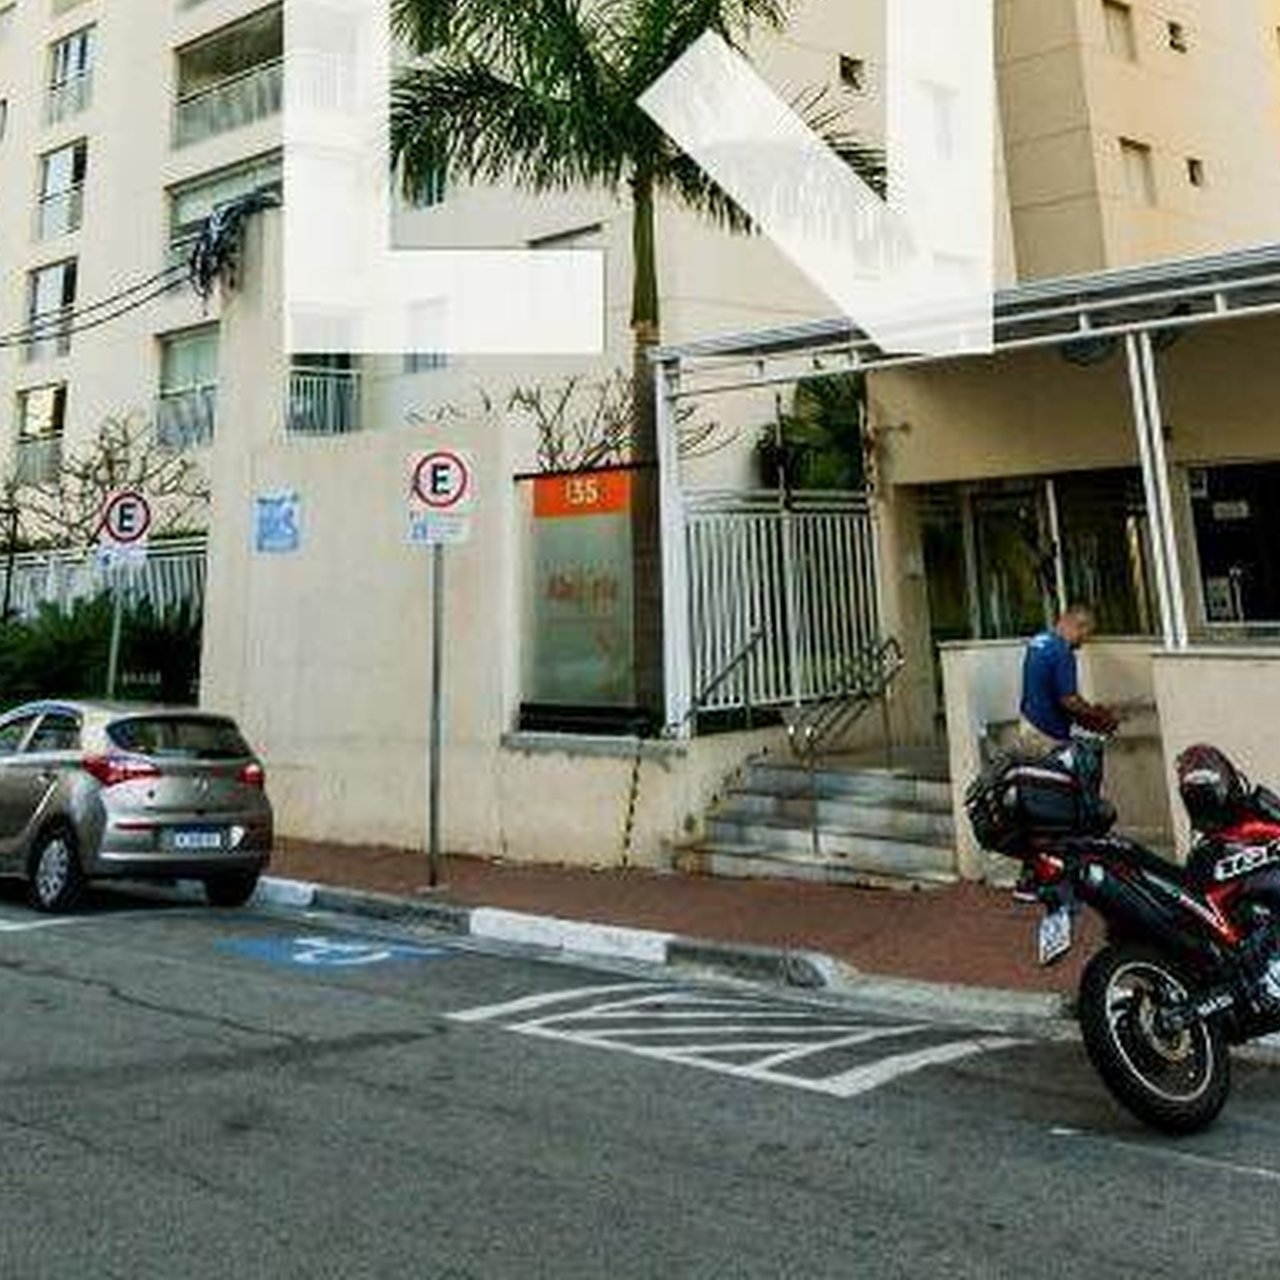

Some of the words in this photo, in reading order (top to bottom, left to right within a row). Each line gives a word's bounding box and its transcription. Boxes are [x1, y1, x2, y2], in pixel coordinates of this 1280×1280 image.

[431, 463, 451, 495] E
[565, 478, 598, 505] 135
[118, 503, 137, 533] E
